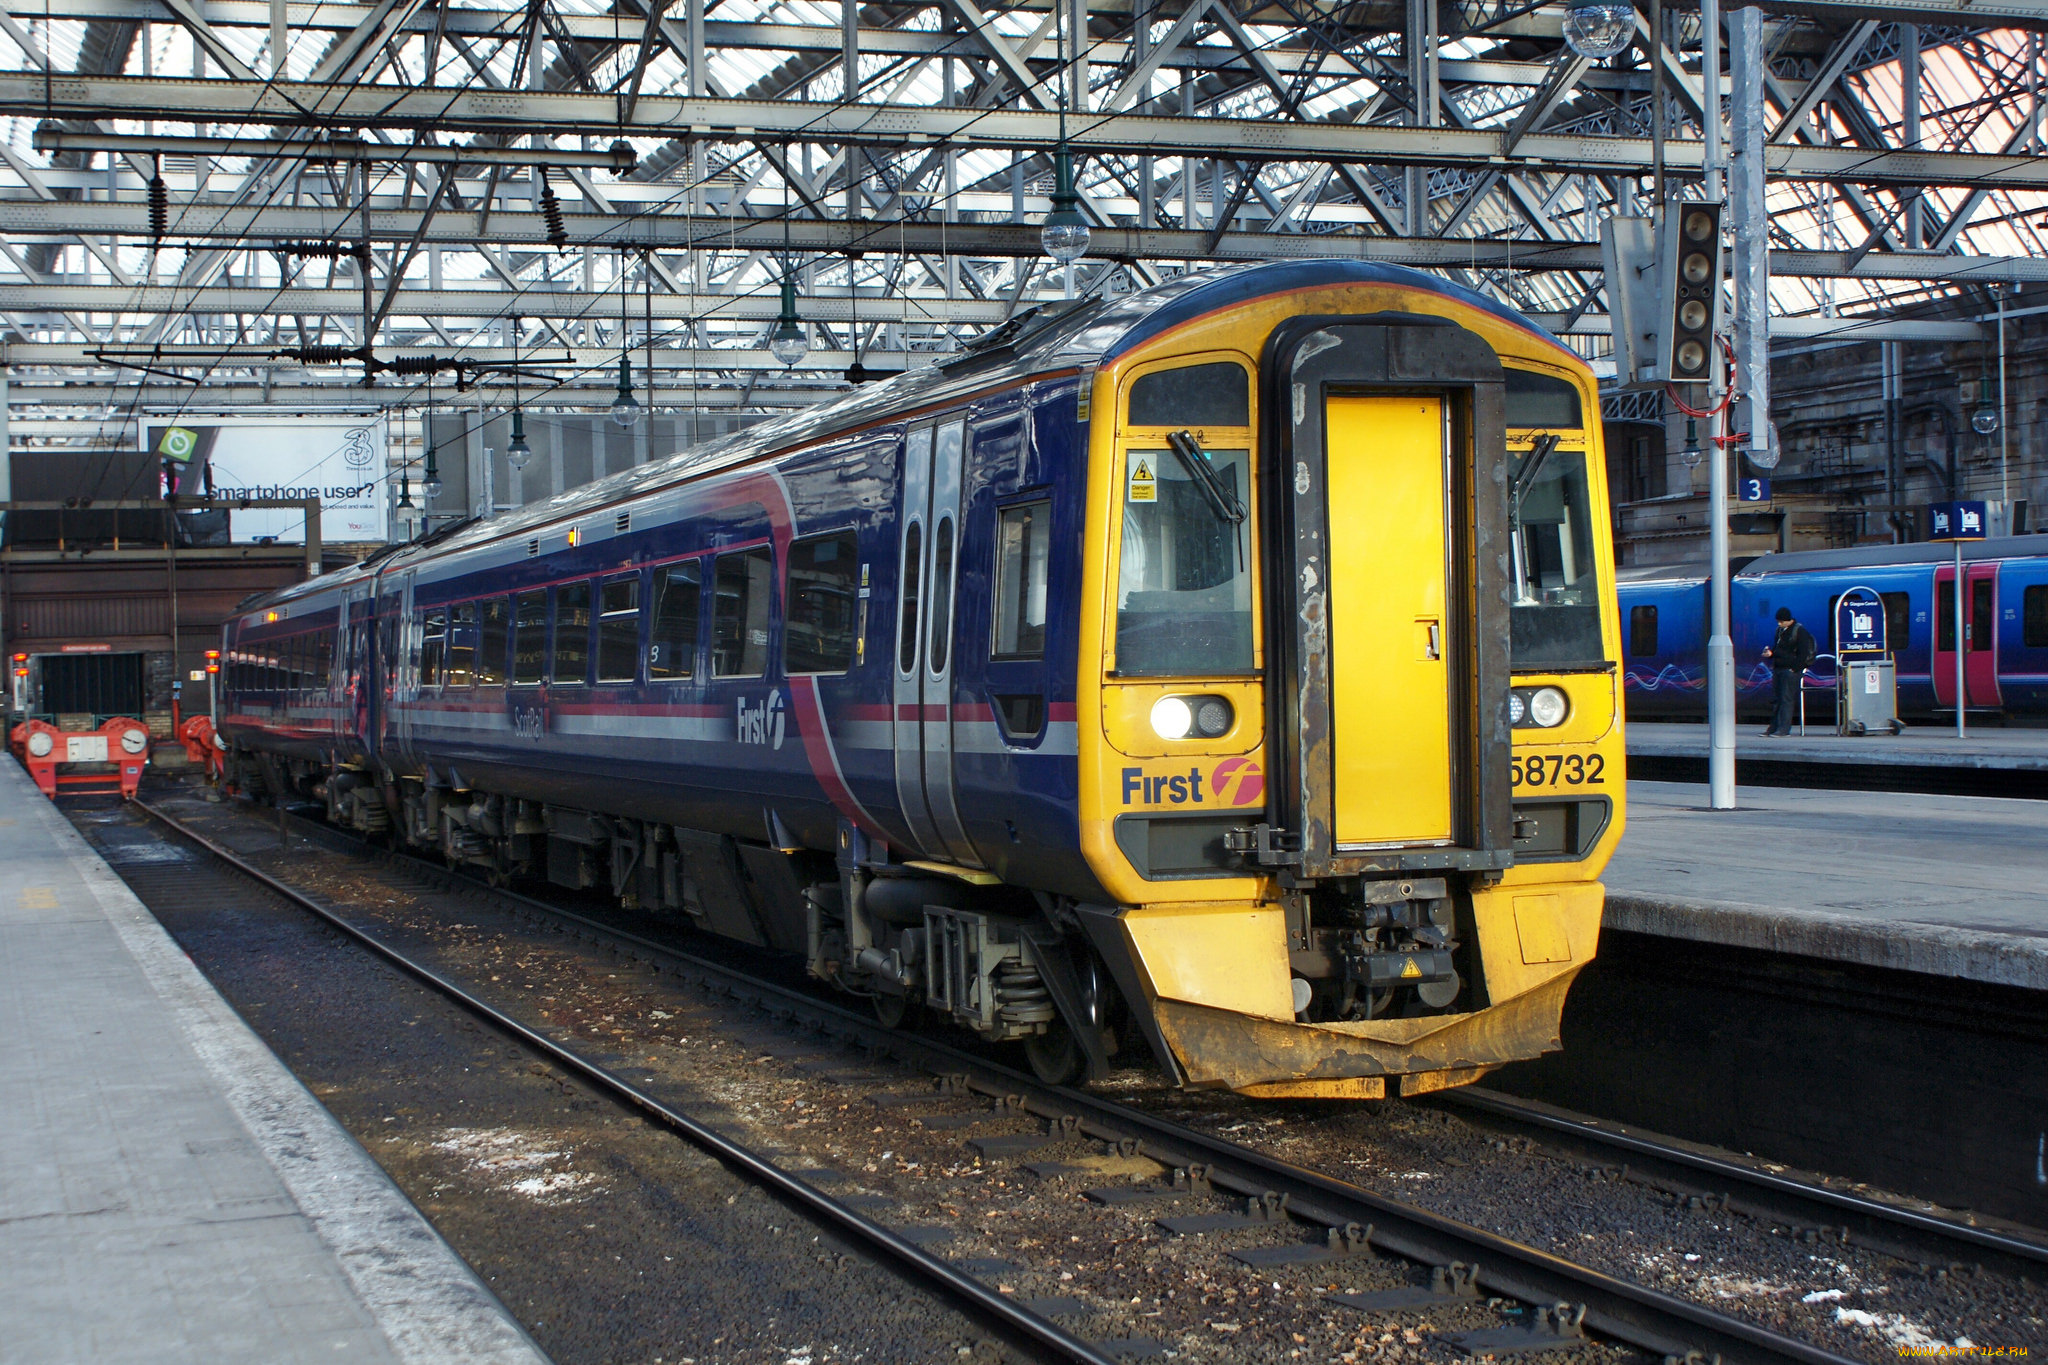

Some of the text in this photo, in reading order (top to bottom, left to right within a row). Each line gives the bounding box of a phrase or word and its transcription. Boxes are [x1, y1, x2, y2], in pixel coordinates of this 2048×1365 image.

[210, 482, 375, 500] Smartphone user?
[1748, 479, 1762, 501] 3
[514, 706, 544, 738] ScotRail
[737, 696, 766, 744] First
[1121, 766, 1203, 805] First
